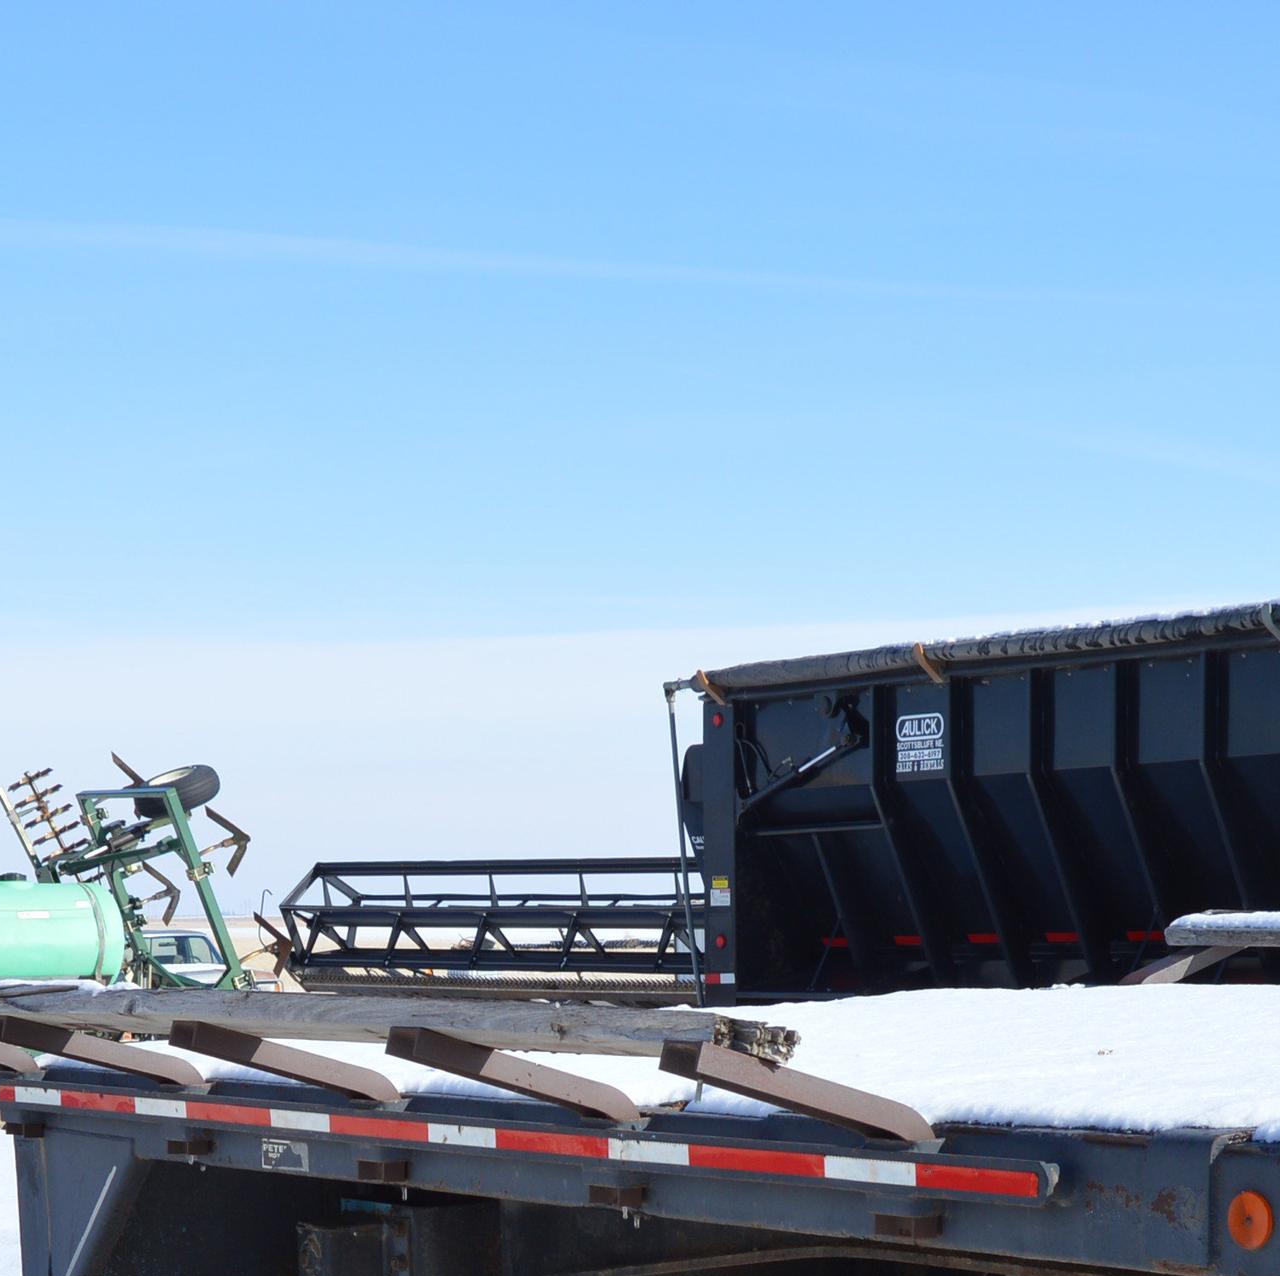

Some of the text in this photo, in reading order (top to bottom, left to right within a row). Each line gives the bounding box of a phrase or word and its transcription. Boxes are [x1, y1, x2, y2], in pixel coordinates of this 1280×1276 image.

[900, 718, 938, 737] AULICK
[896, 762, 913, 773] SALES
[920, 759, 945, 771] RENTALS
